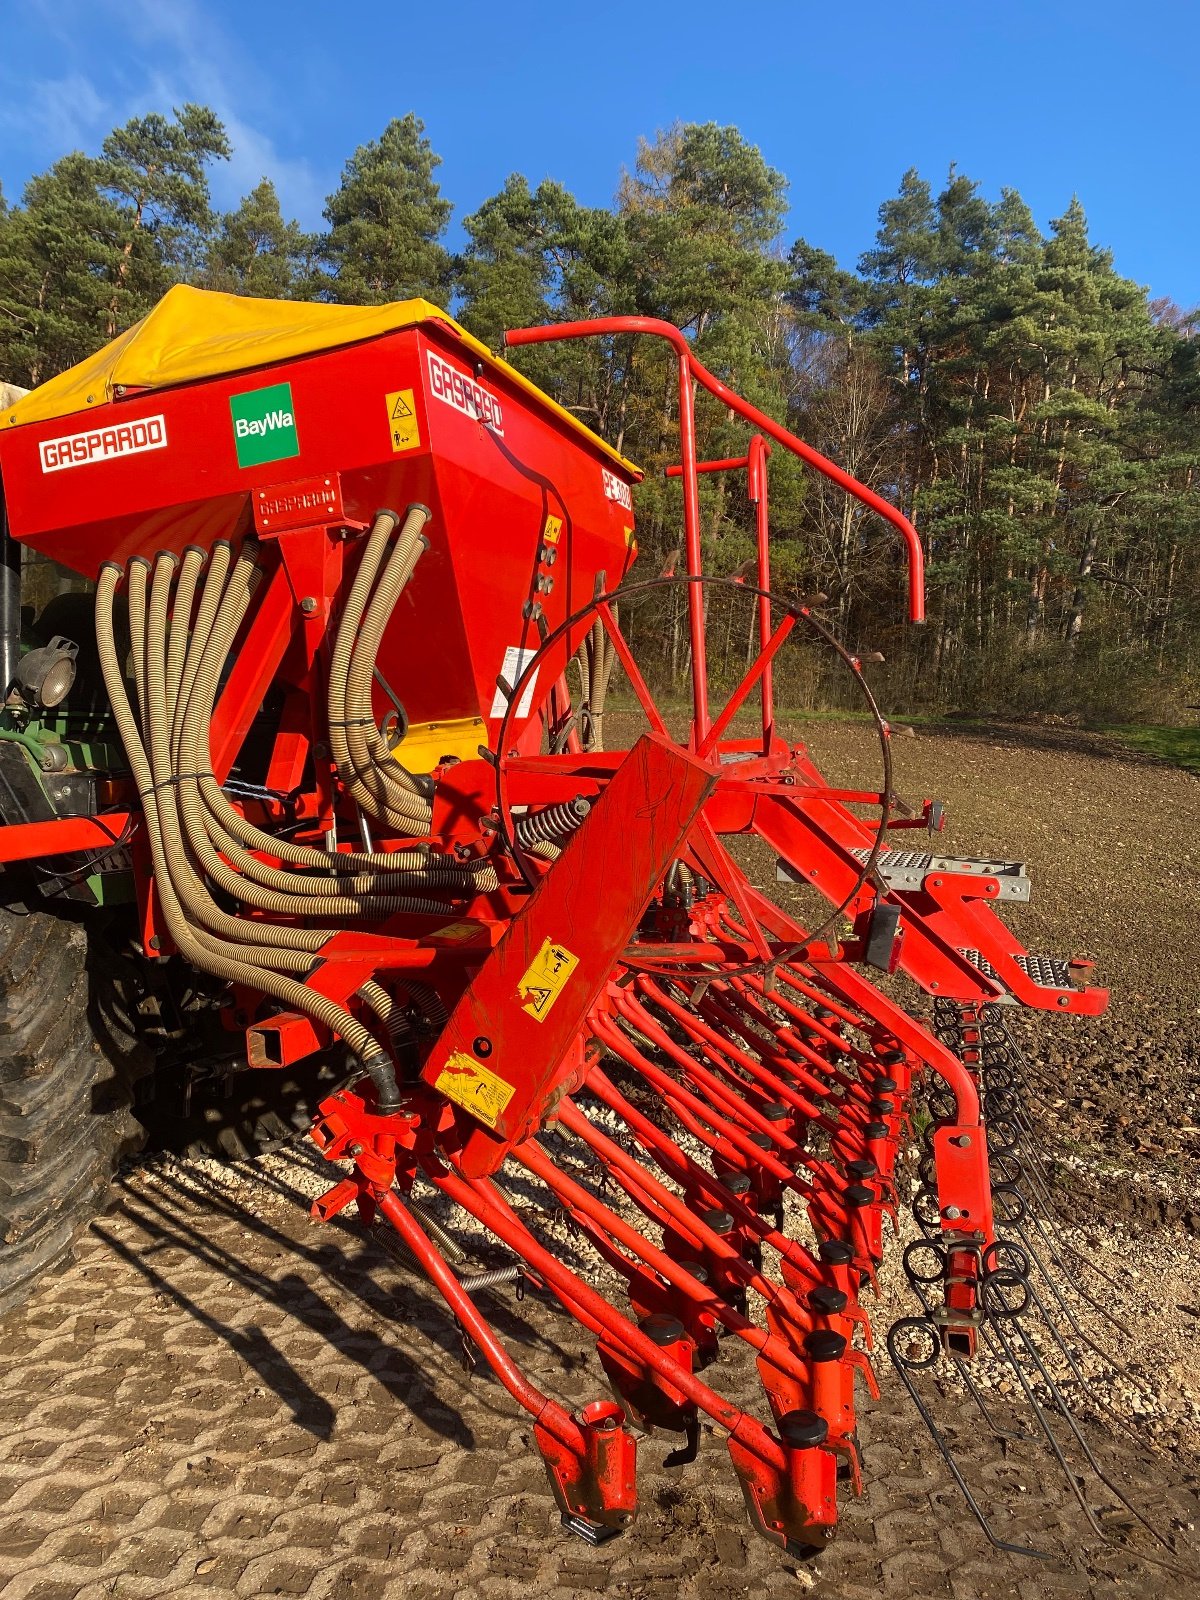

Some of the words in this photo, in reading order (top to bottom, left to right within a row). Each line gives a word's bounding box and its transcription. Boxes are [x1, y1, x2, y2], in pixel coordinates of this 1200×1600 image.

[235, 410, 293, 438] BayWa
[43, 419, 163, 468] GASPARDO
[259, 489, 336, 515] GASPARDO
